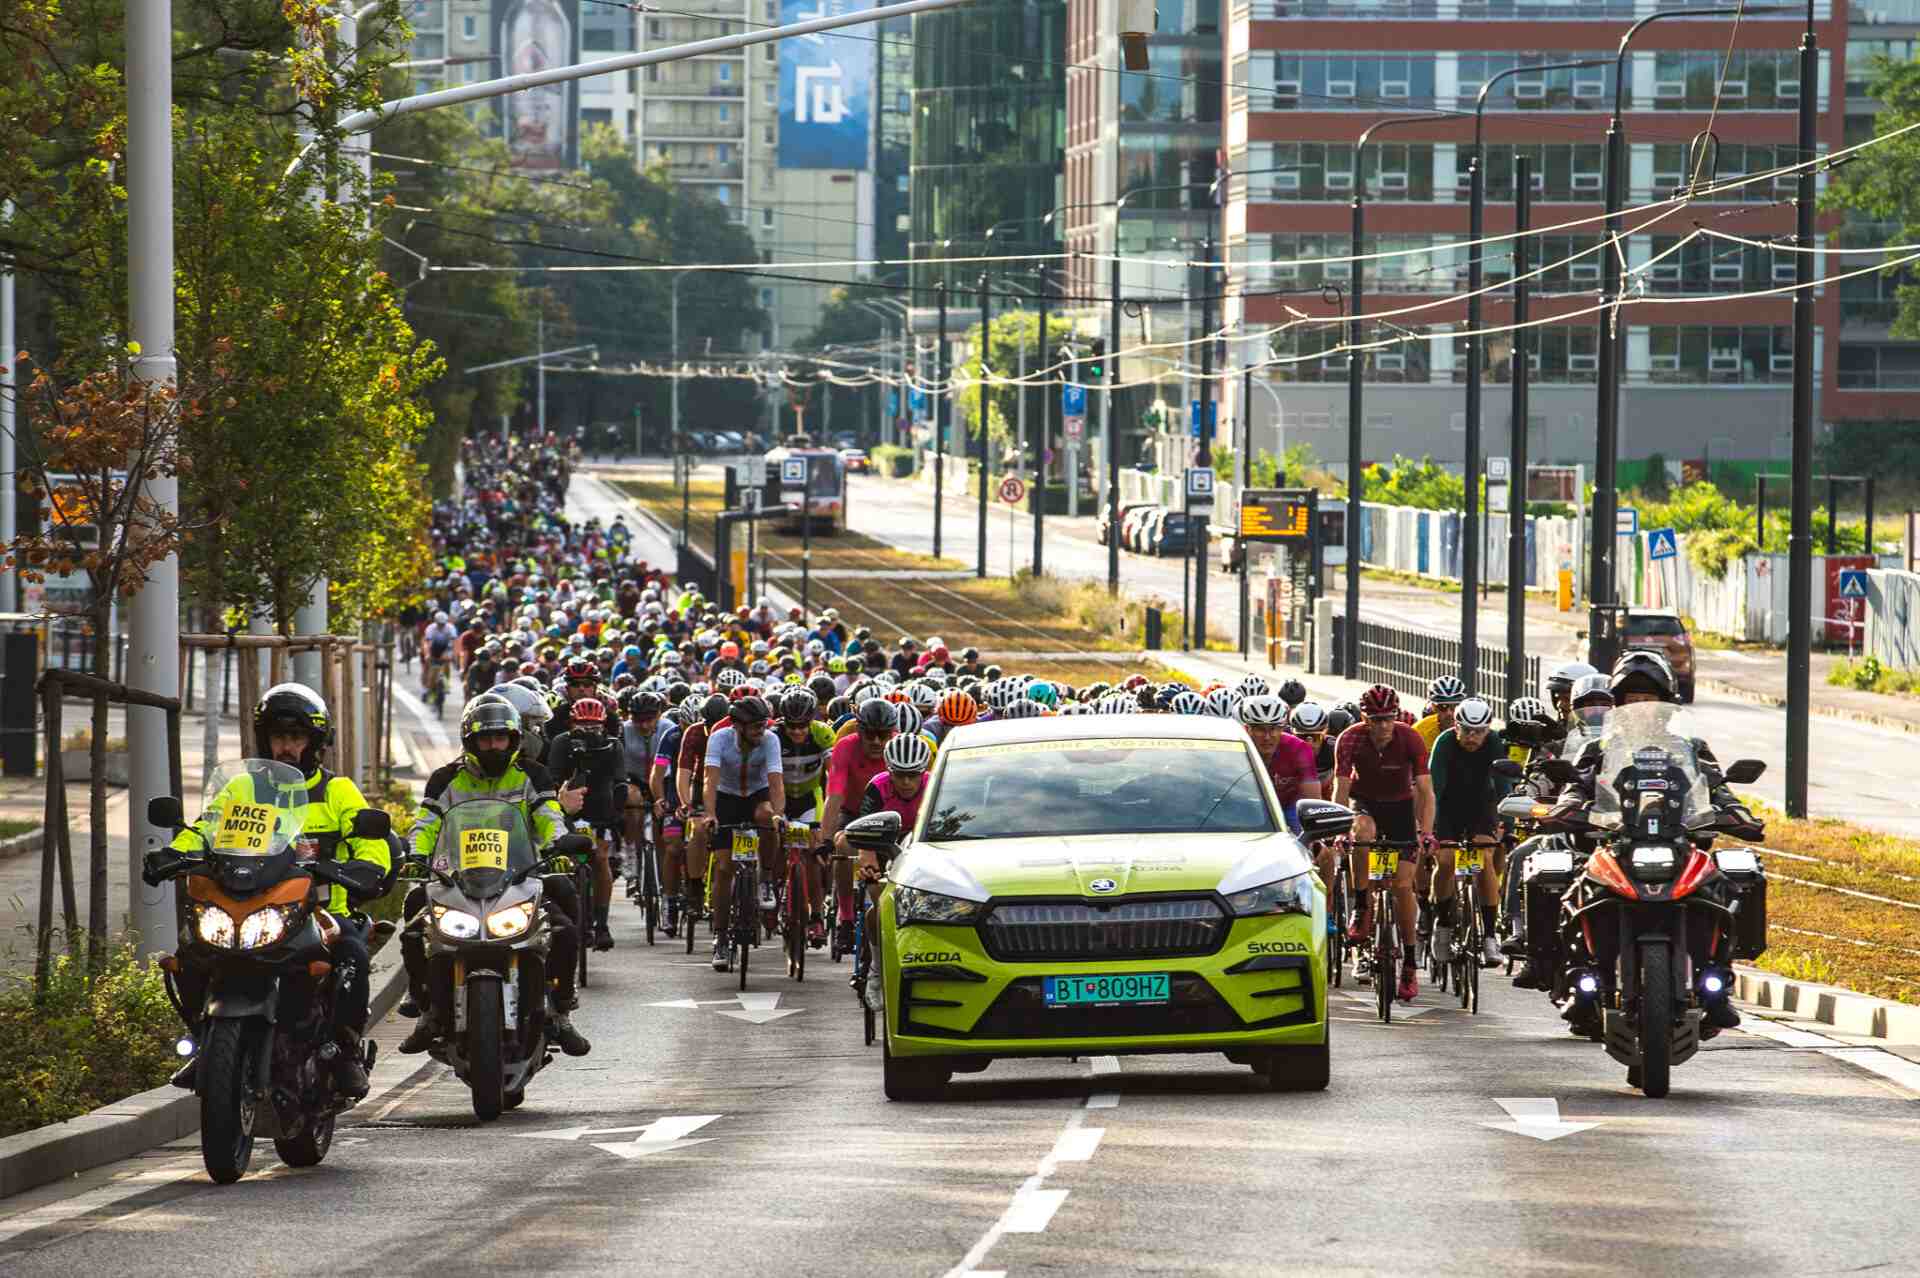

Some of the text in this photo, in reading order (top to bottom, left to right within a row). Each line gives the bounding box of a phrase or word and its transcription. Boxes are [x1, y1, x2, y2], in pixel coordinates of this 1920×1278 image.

[231, 805, 268, 820] RACE
[224, 819, 266, 834] MOTO
[247, 837, 262, 848] 10
[468, 832, 500, 842] RACE
[465, 843, 502, 854] MOTO
[495, 857, 502, 866] 8
[1057, 976, 1166, 1000] BT 809HZ
